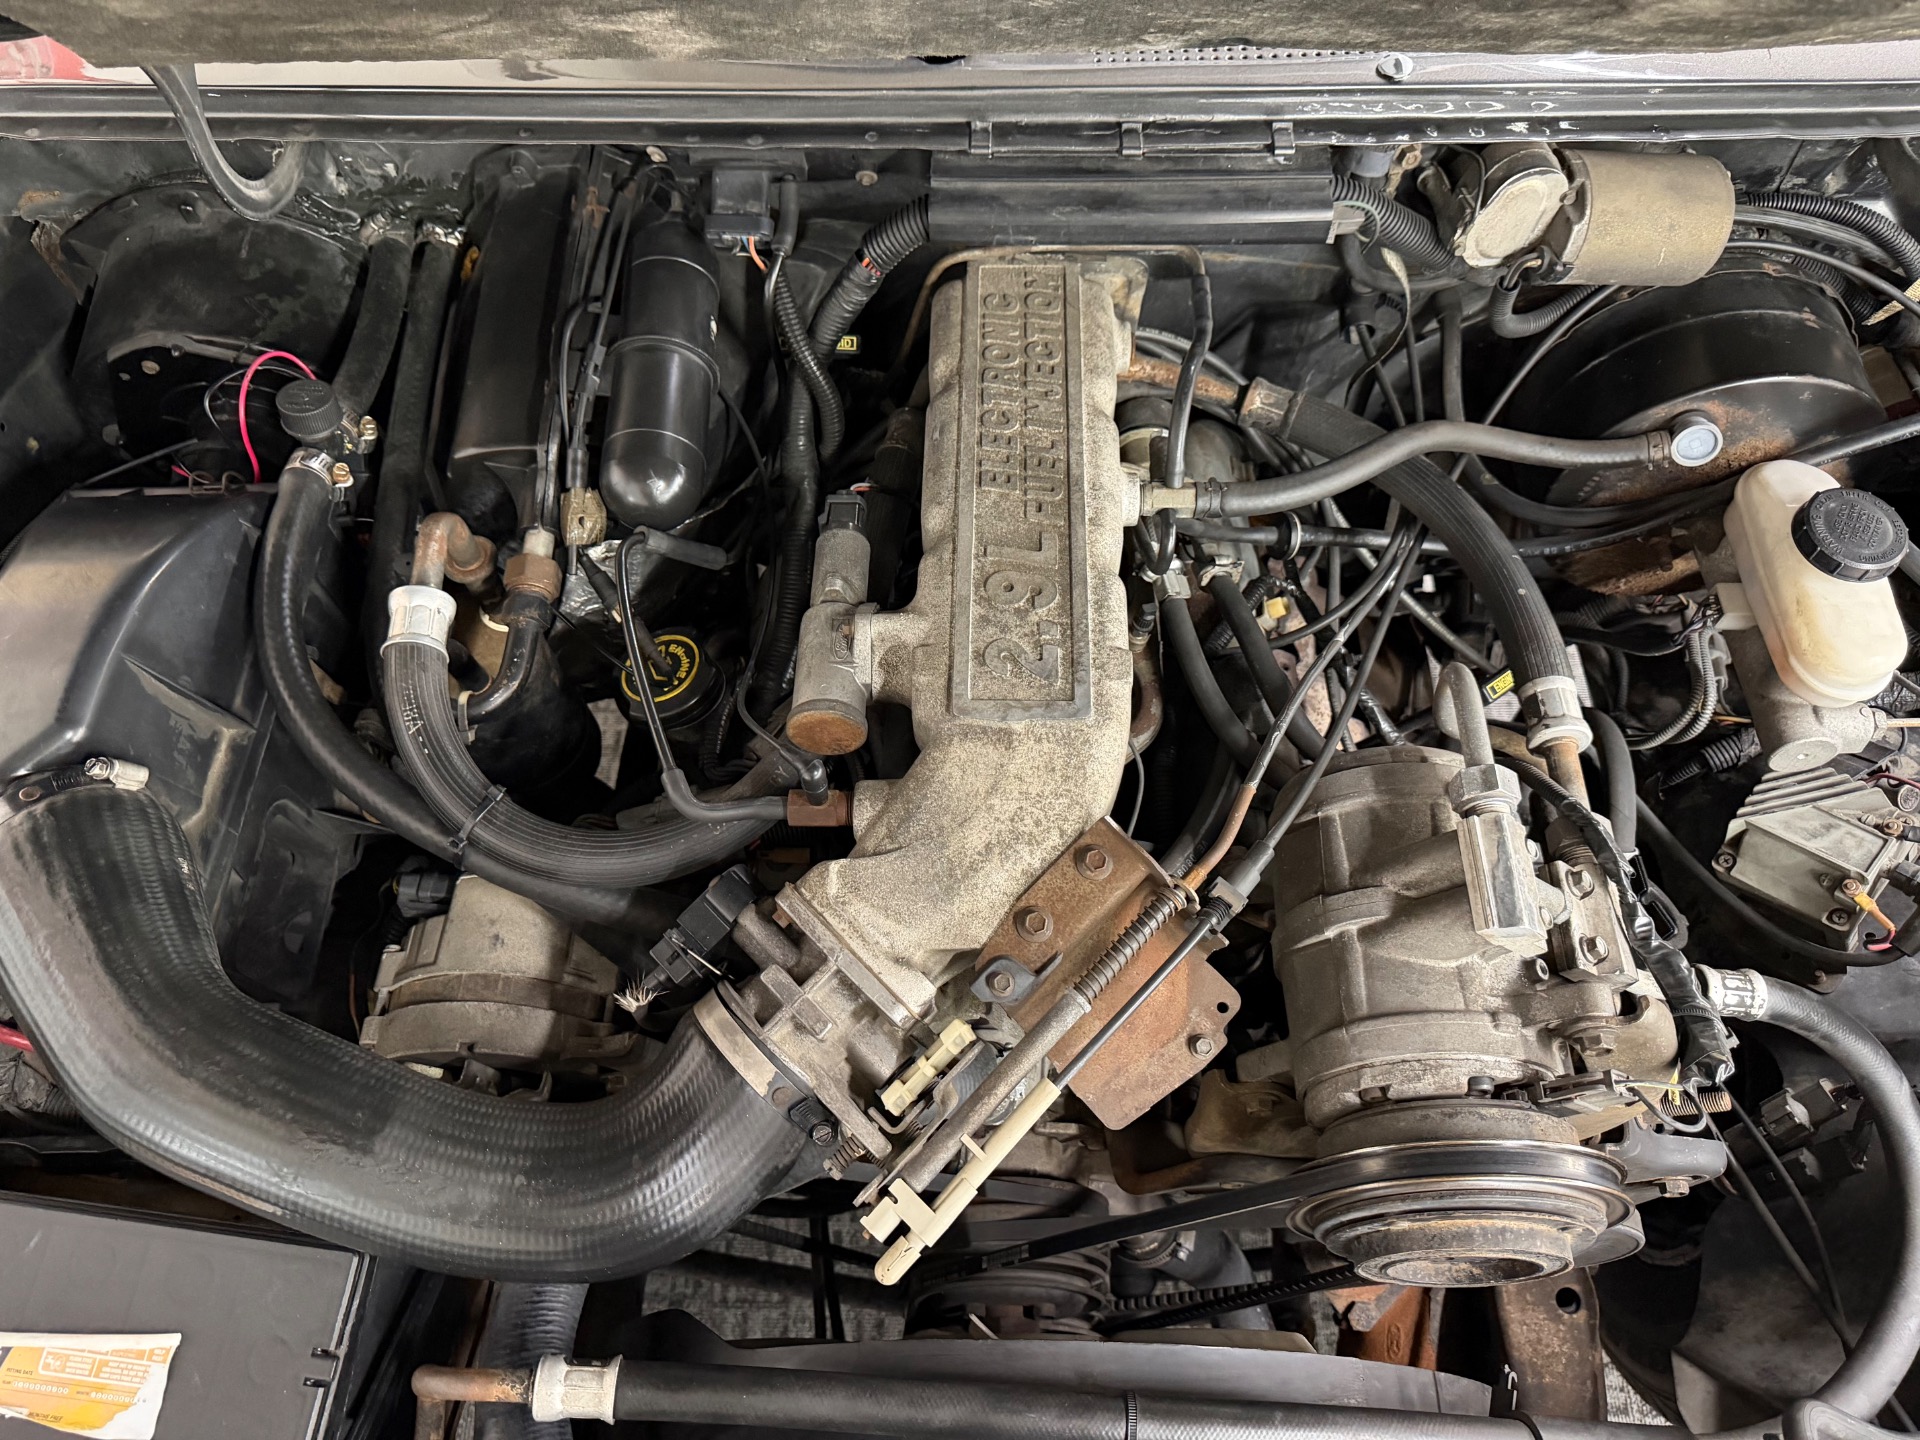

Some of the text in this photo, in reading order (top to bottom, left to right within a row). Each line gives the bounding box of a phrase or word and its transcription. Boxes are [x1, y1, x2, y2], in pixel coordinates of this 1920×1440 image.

[979, 292, 1020, 492] ELECTRONIC
[1022, 268, 1064, 522] FUEL INJECTION
[983, 530, 1060, 686] 2.9L
[1811, 513, 1844, 554] WARNING
[668, 644, 690, 679] ENGINE
